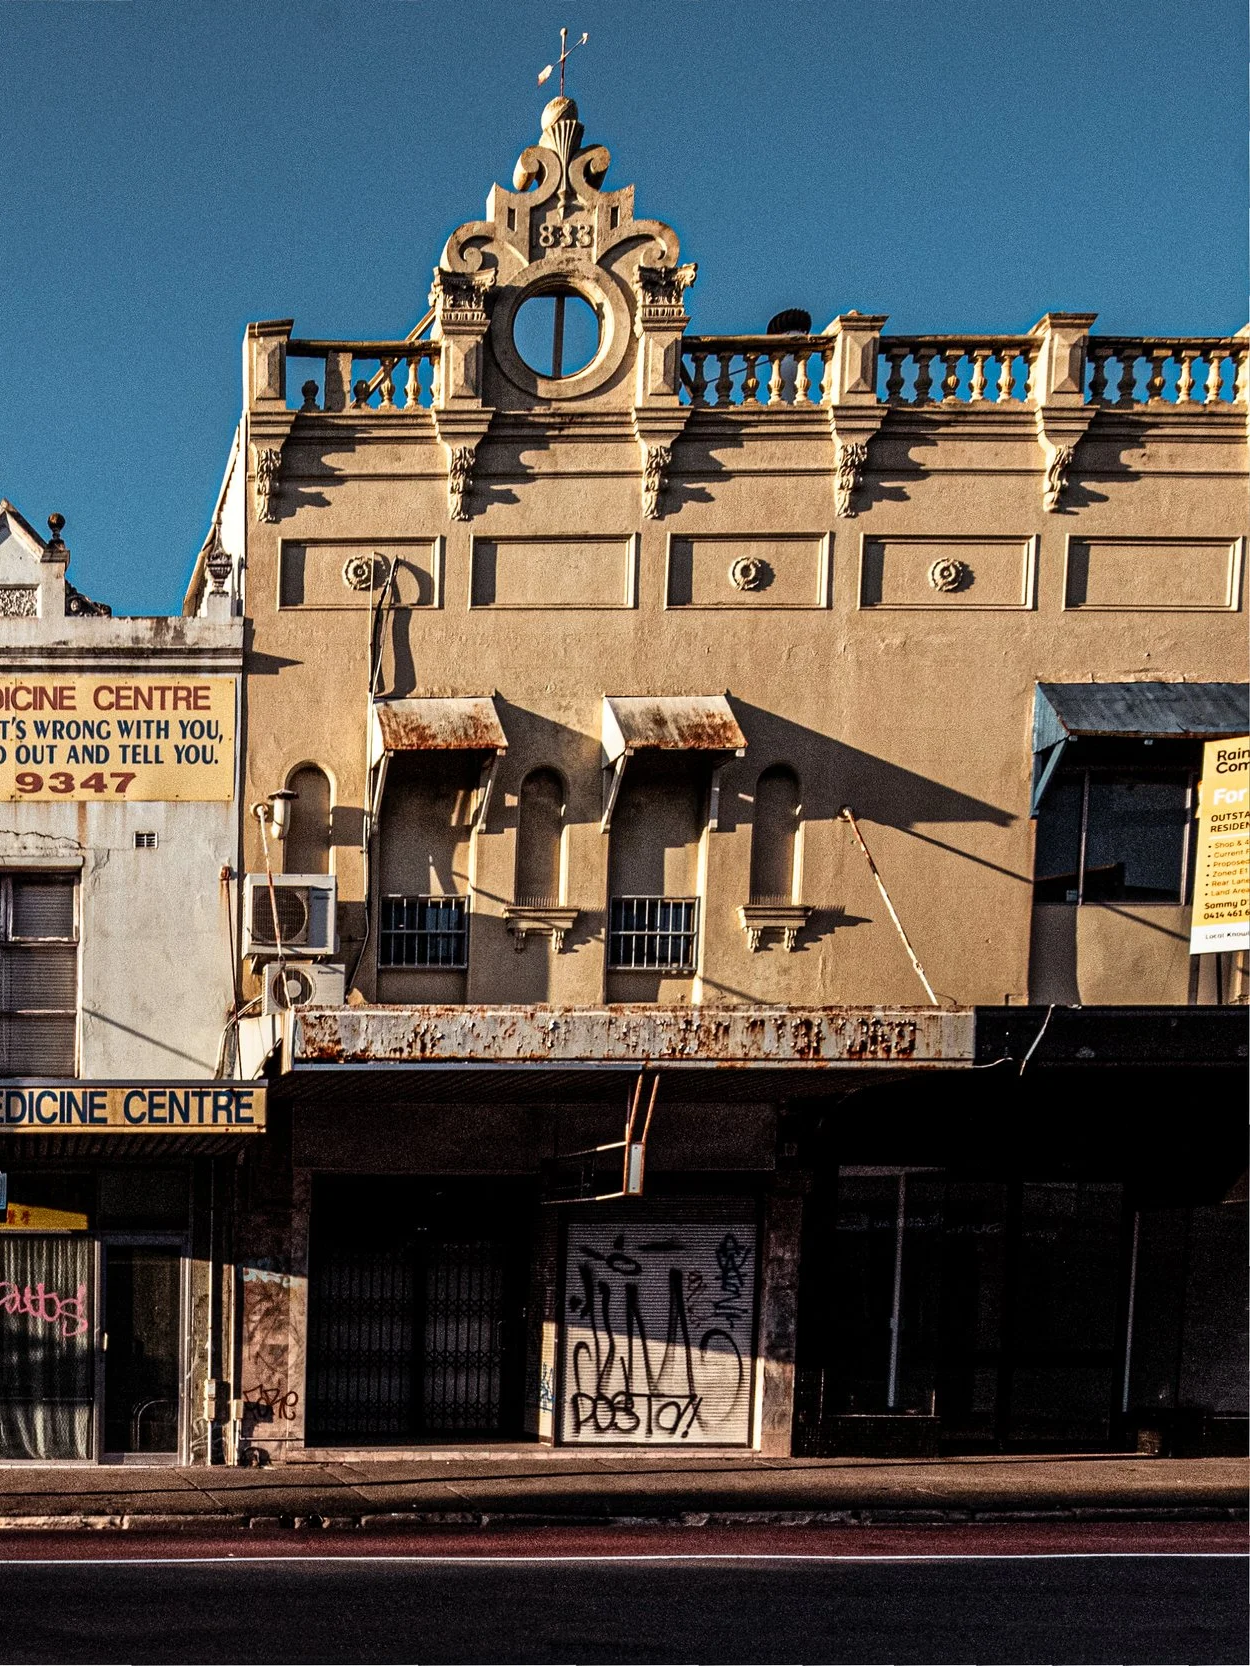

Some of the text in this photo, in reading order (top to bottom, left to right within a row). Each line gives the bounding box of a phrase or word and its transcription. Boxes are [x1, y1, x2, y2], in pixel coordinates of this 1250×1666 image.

[93, 685, 211, 711] CENTRE
[33, 719, 111, 740] WRONG
[117, 719, 170, 740] WITH
[178, 719, 224, 744] YOU,
[15, 744, 58, 765] OUT
[66, 744, 110, 764] AND
[118, 744, 165, 764] TELL
[173, 744, 219, 764] YOU.
[15, 772, 137, 794] 9347
[1213, 787, 1248, 806] For
[1213, 849, 1244, 858] Current
[1214, 841, 1235, 850] Shop
[1212, 869, 1237, 878] Zoned
[1203, 911, 1225, 920] 0414
[1226, 909, 1243, 918] 461
[1204, 901, 1238, 911] Sammy
[122, 1089, 254, 1124] CENTRE
